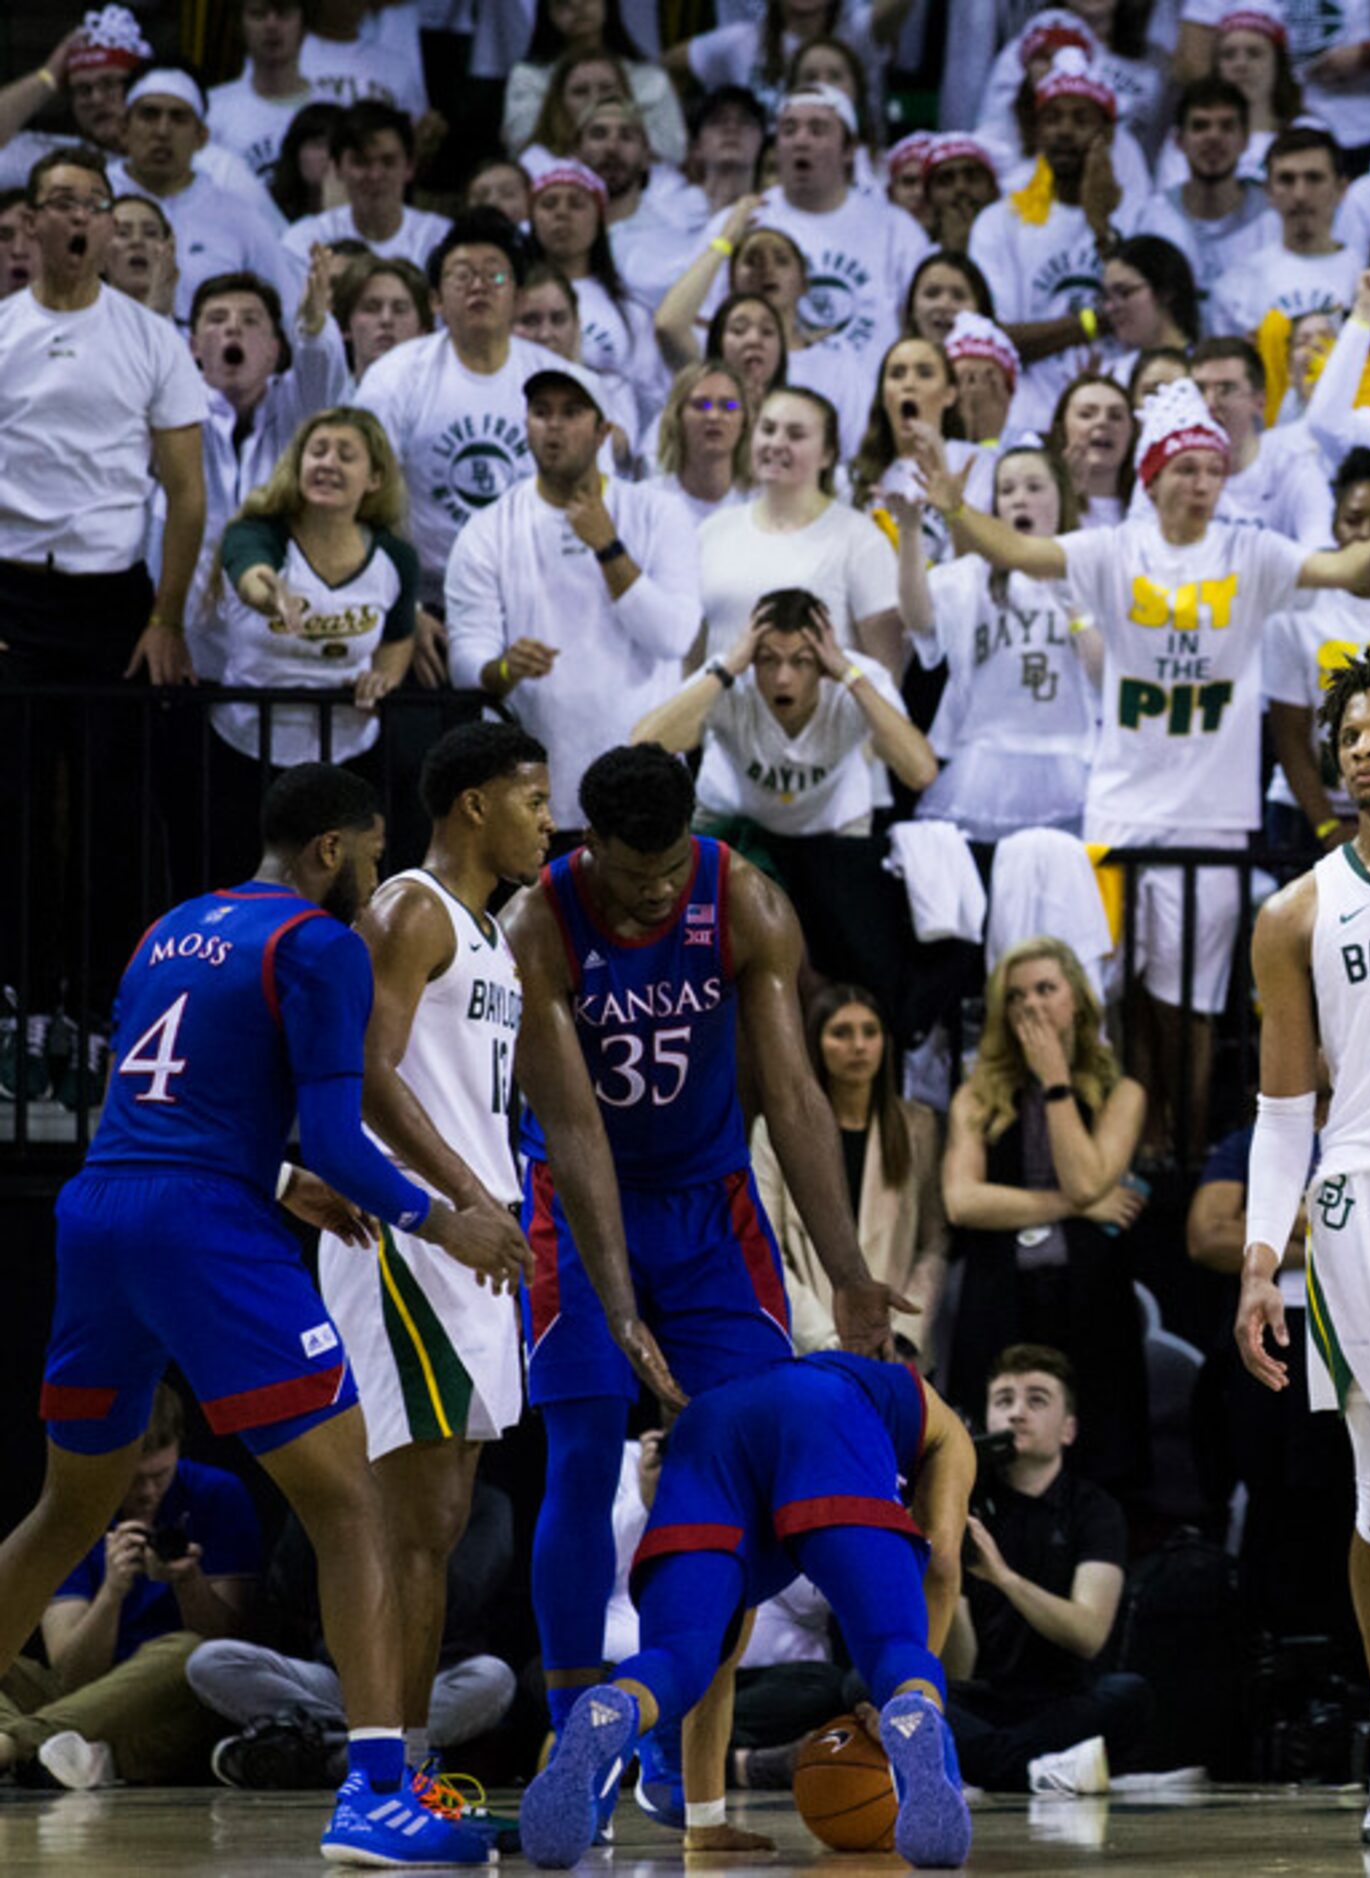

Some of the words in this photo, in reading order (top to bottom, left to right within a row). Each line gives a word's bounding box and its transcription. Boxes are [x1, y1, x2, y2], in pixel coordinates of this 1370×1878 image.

[432, 414, 475, 459] LIVE
[483, 413, 529, 458] FROM
[1128, 571, 1239, 631] SIT
[974, 608, 1079, 668] BAYL
[1167, 632, 1200, 656] IN
[1155, 656, 1212, 681] THE
[1117, 676, 1235, 738] PIT
[149, 931, 233, 967] MOSS
[572, 976, 722, 1028] KANSAS
[118, 990, 189, 1103] 4
[595, 1025, 692, 1108] 35
[1316, 1173, 1356, 1231] BU
